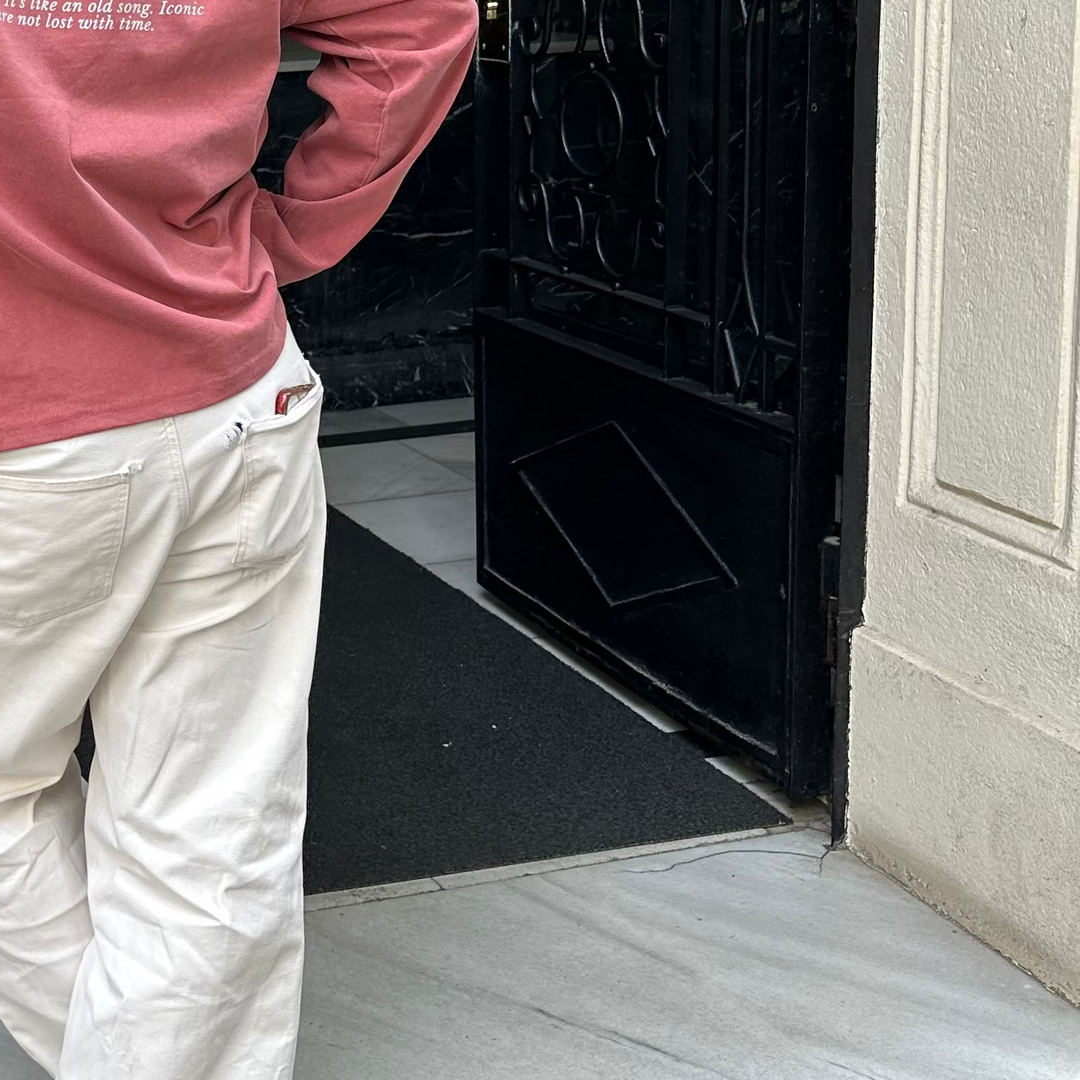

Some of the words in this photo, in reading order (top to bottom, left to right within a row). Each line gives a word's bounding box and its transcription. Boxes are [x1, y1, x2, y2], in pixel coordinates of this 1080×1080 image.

[62, 1, 83, 13] an
[117, 2, 153, 18] song.
[159, 1, 204, 16] Iconic
[18, 12, 42, 27] not
[46, 15, 73, 29] lost
[78, 14, 114, 30] with
[119, 16, 155, 32] time.
